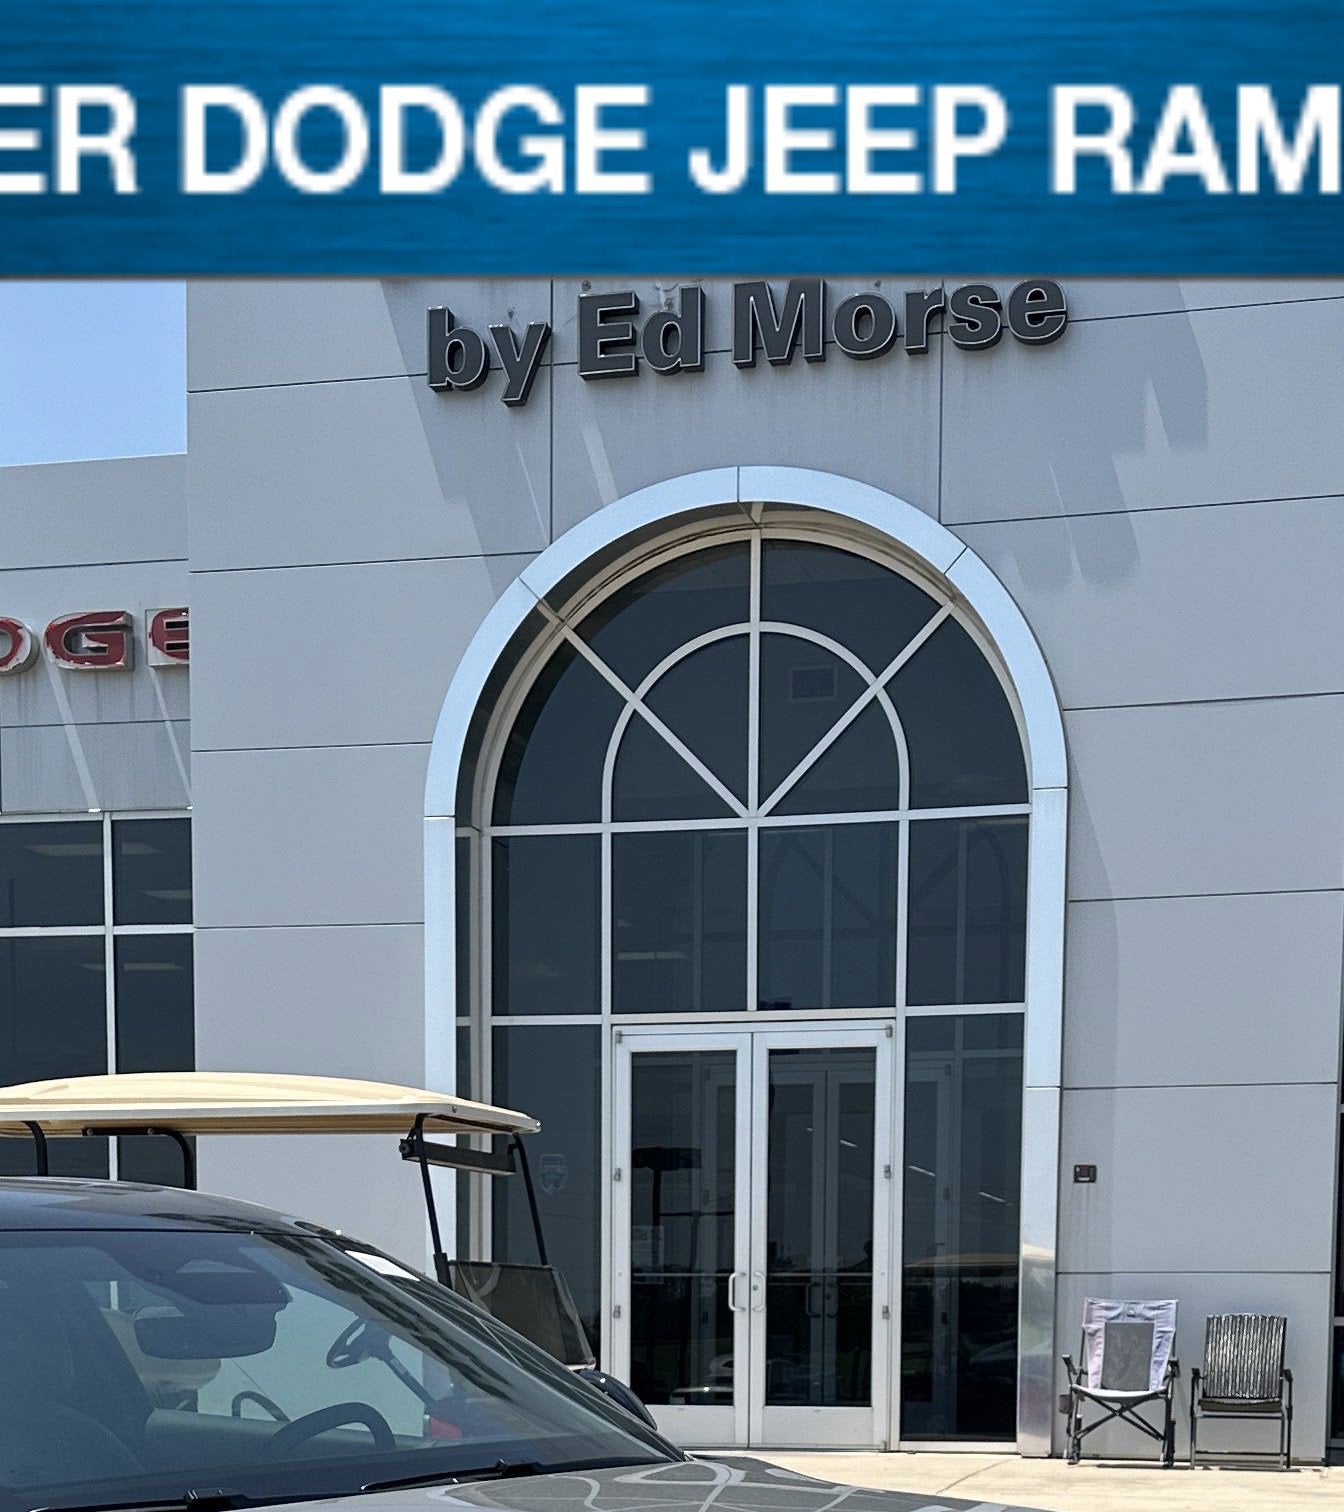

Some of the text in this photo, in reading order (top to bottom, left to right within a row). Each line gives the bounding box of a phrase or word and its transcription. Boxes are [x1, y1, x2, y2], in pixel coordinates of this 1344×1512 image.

[427, 278, 1069, 406] by Ed Morse
